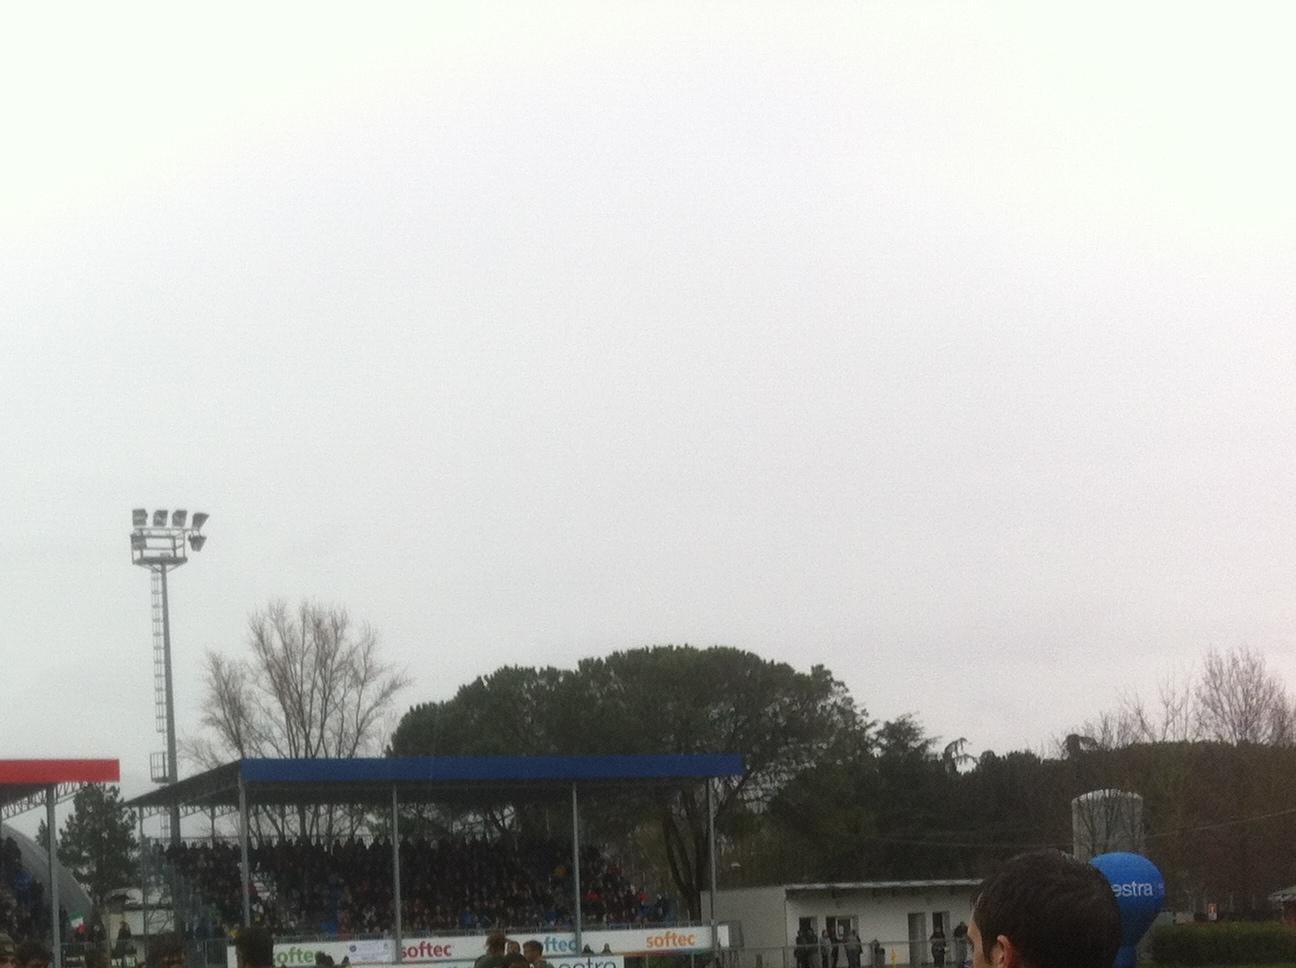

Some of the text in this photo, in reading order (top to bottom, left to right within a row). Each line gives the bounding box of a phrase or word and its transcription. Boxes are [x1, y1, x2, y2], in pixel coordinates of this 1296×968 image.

[1111, 880, 1154, 898] estra
[646, 931, 696, 949] softec
[400, 941, 452, 958] softec
